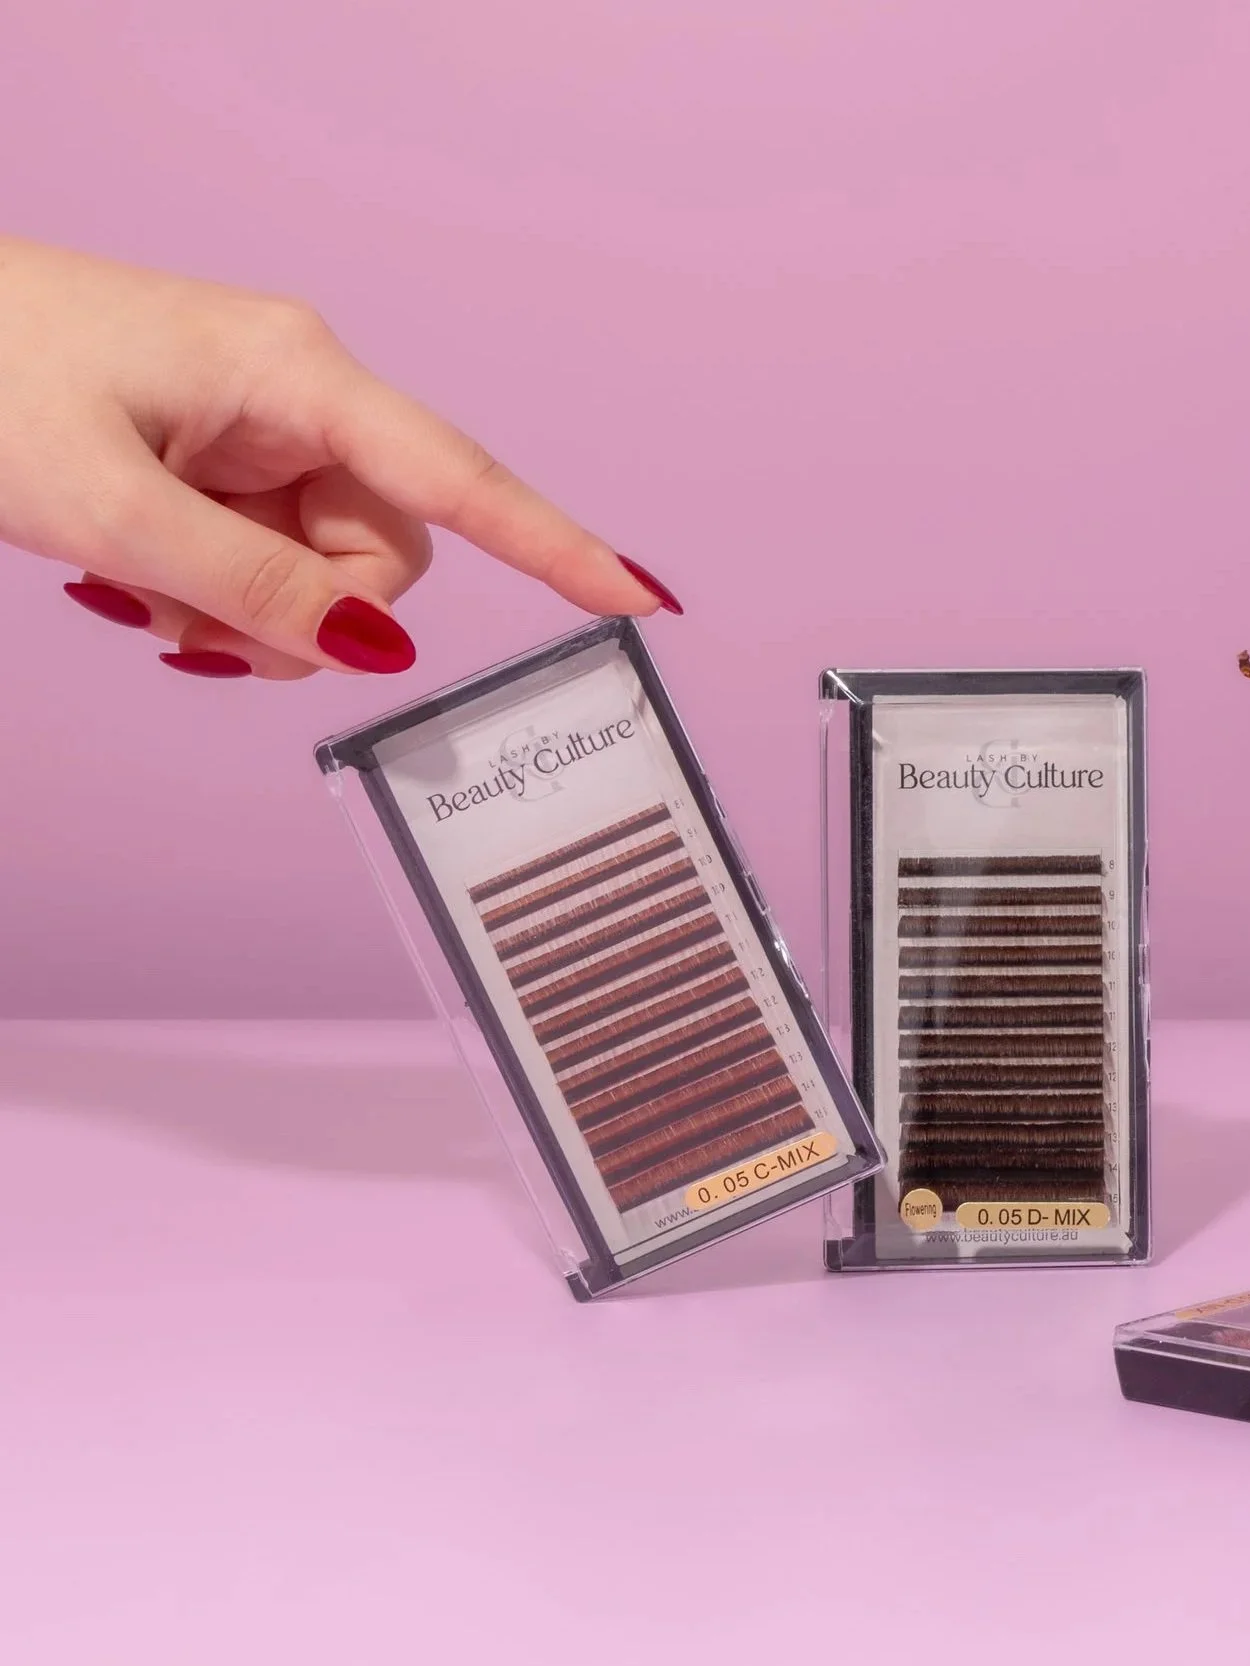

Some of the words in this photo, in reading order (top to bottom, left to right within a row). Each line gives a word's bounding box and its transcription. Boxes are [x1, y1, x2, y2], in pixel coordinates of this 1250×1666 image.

[489, 745, 530, 769] LASH
[540, 730, 560, 746] BY
[966, 754, 1008, 763] LASH
[1020, 753, 1038, 763] BY
[426, 763, 526, 824] Beauty
[533, 719, 636, 774] Culture
[897, 762, 997, 799] Beauty
[1003, 761, 1104, 790] Culture
[753, 1140, 821, 1181] C-MIX
[905, 1202, 937, 1218] Flowering
[925, 1230, 1079, 1245] www.beautyculture.au
